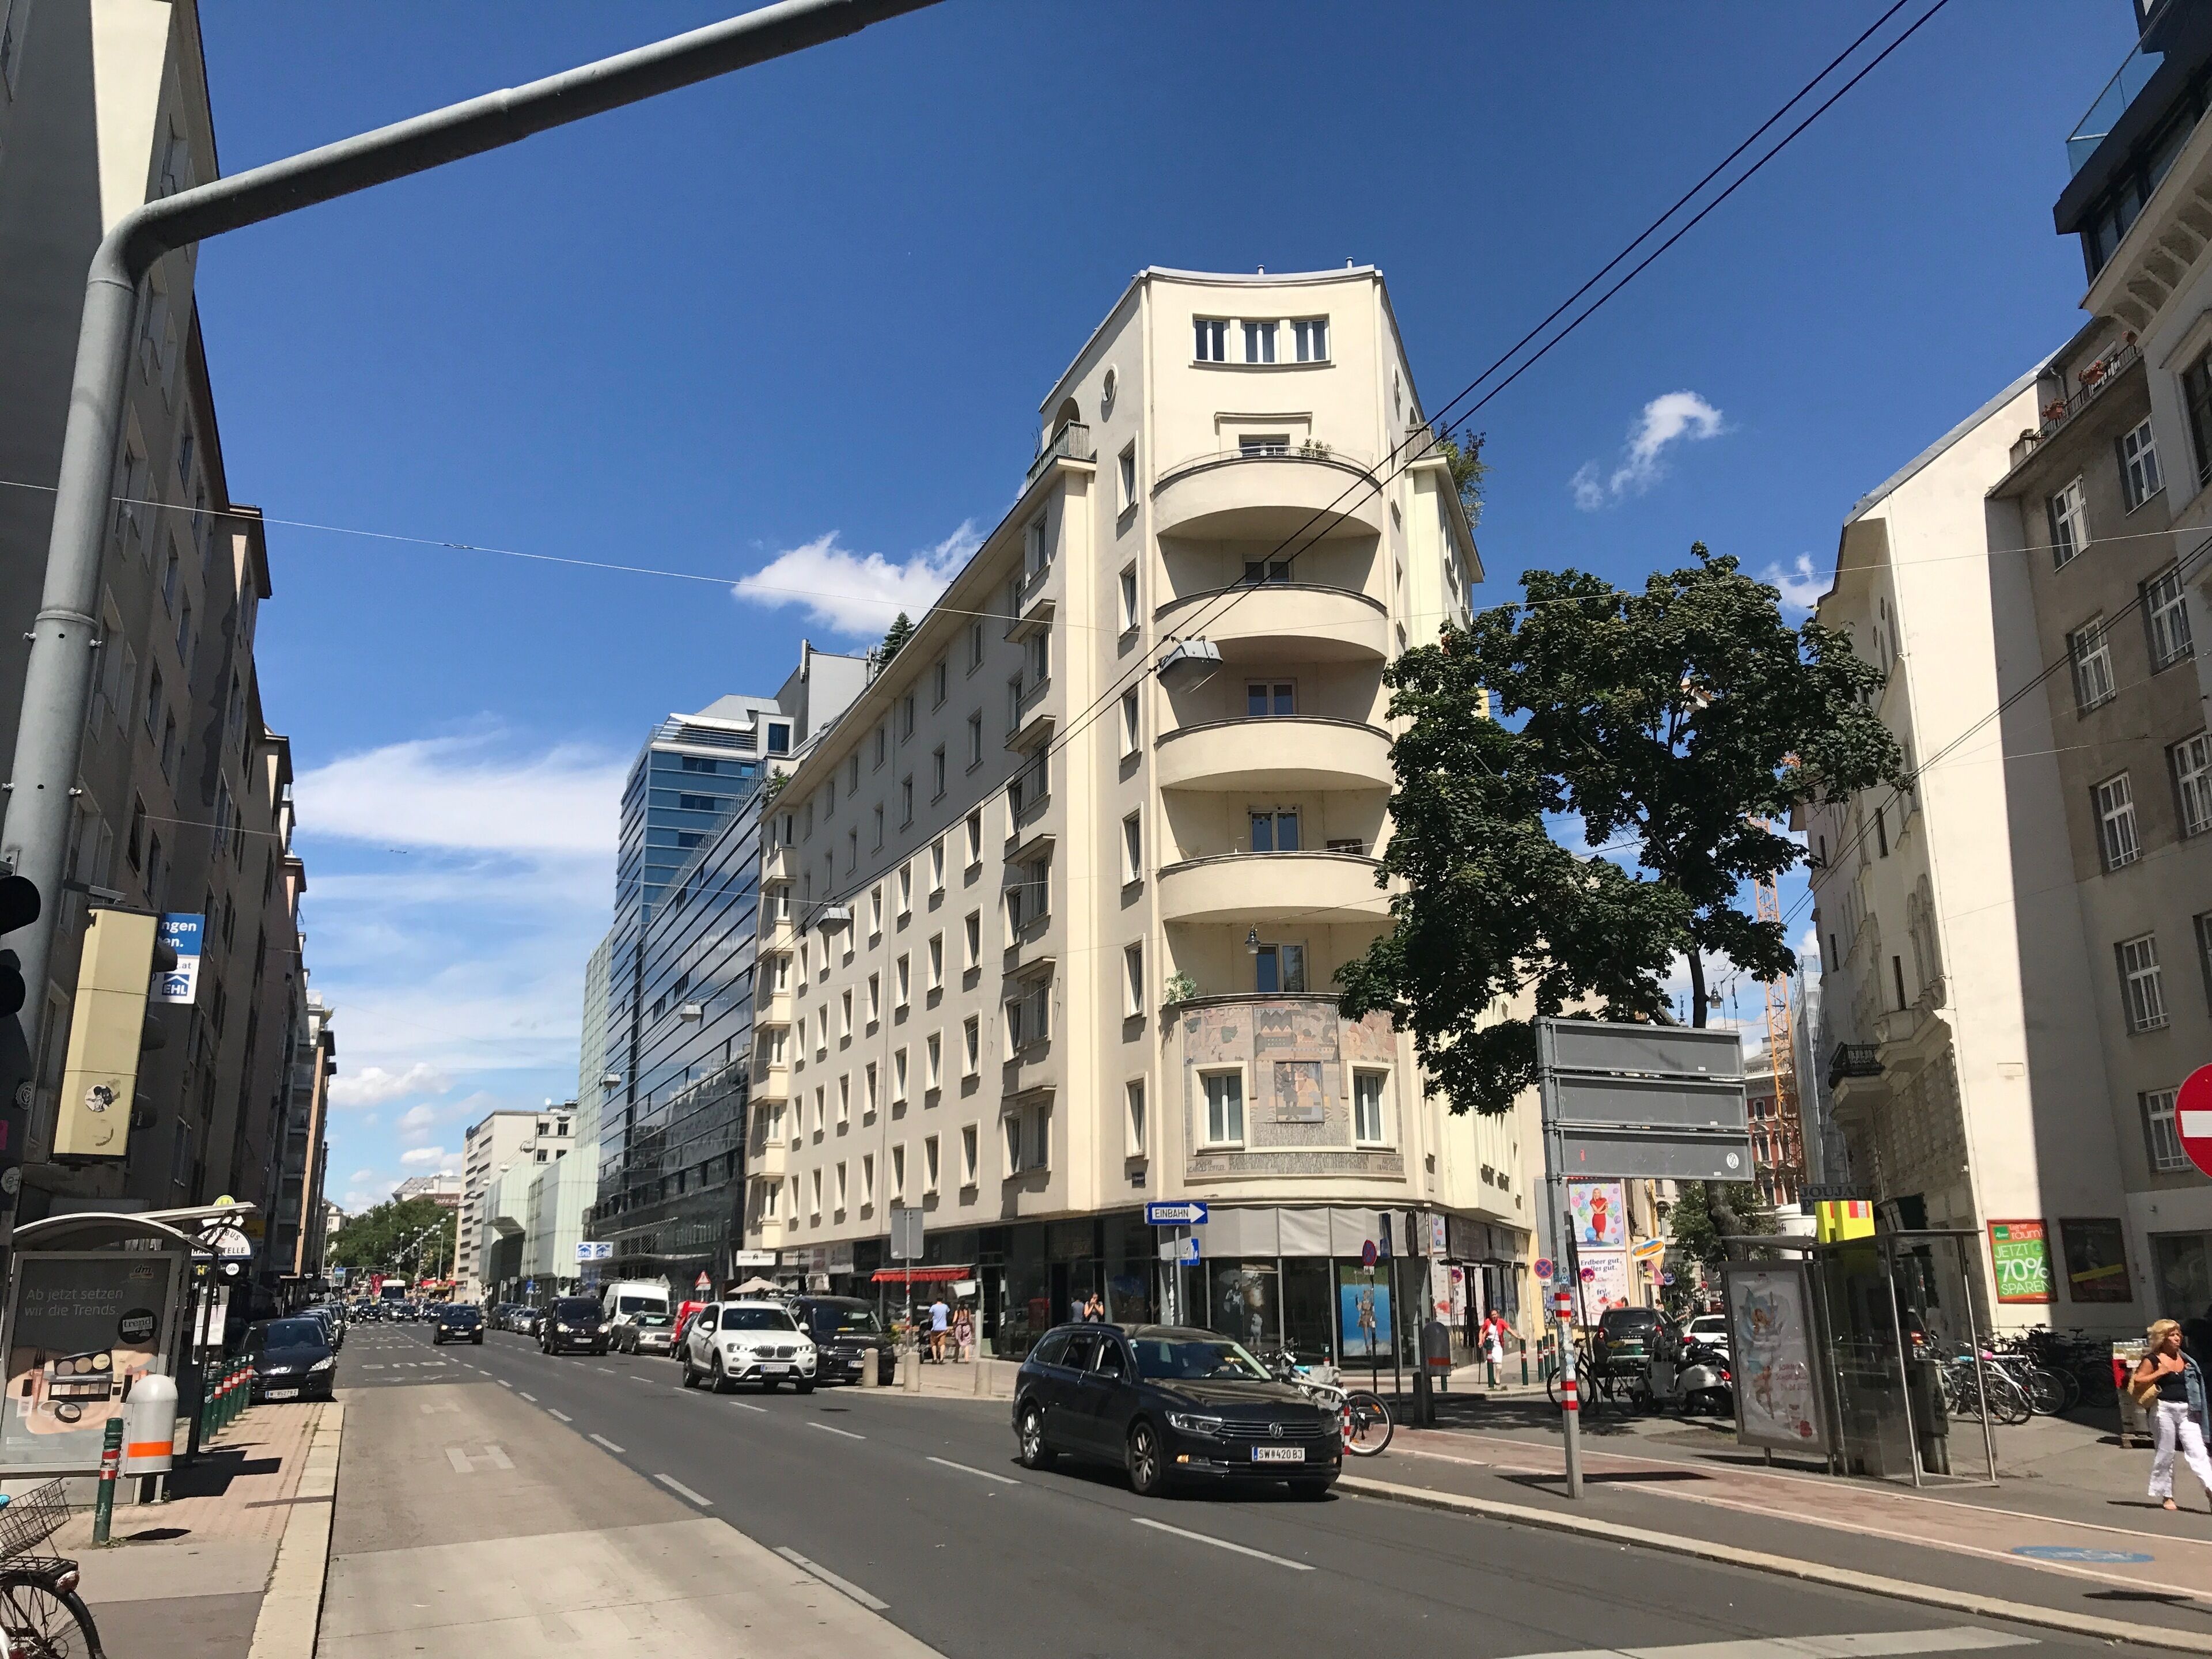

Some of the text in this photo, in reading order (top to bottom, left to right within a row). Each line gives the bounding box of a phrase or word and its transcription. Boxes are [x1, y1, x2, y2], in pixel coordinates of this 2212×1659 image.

[163, 984, 187, 994] EHL
[1155, 1209, 1189, 1218] EINBAHN
[1995, 1243, 2028, 1259] JETZT
[1996, 1256, 2048, 1282] 70%
[2001, 1280, 2051, 1296] SPAREN
[26, 1288, 123, 1302] Ab jetzt setzen
[24, 1304, 119, 1316] wir die Trends.
[123, 1317, 151, 1328] trend
